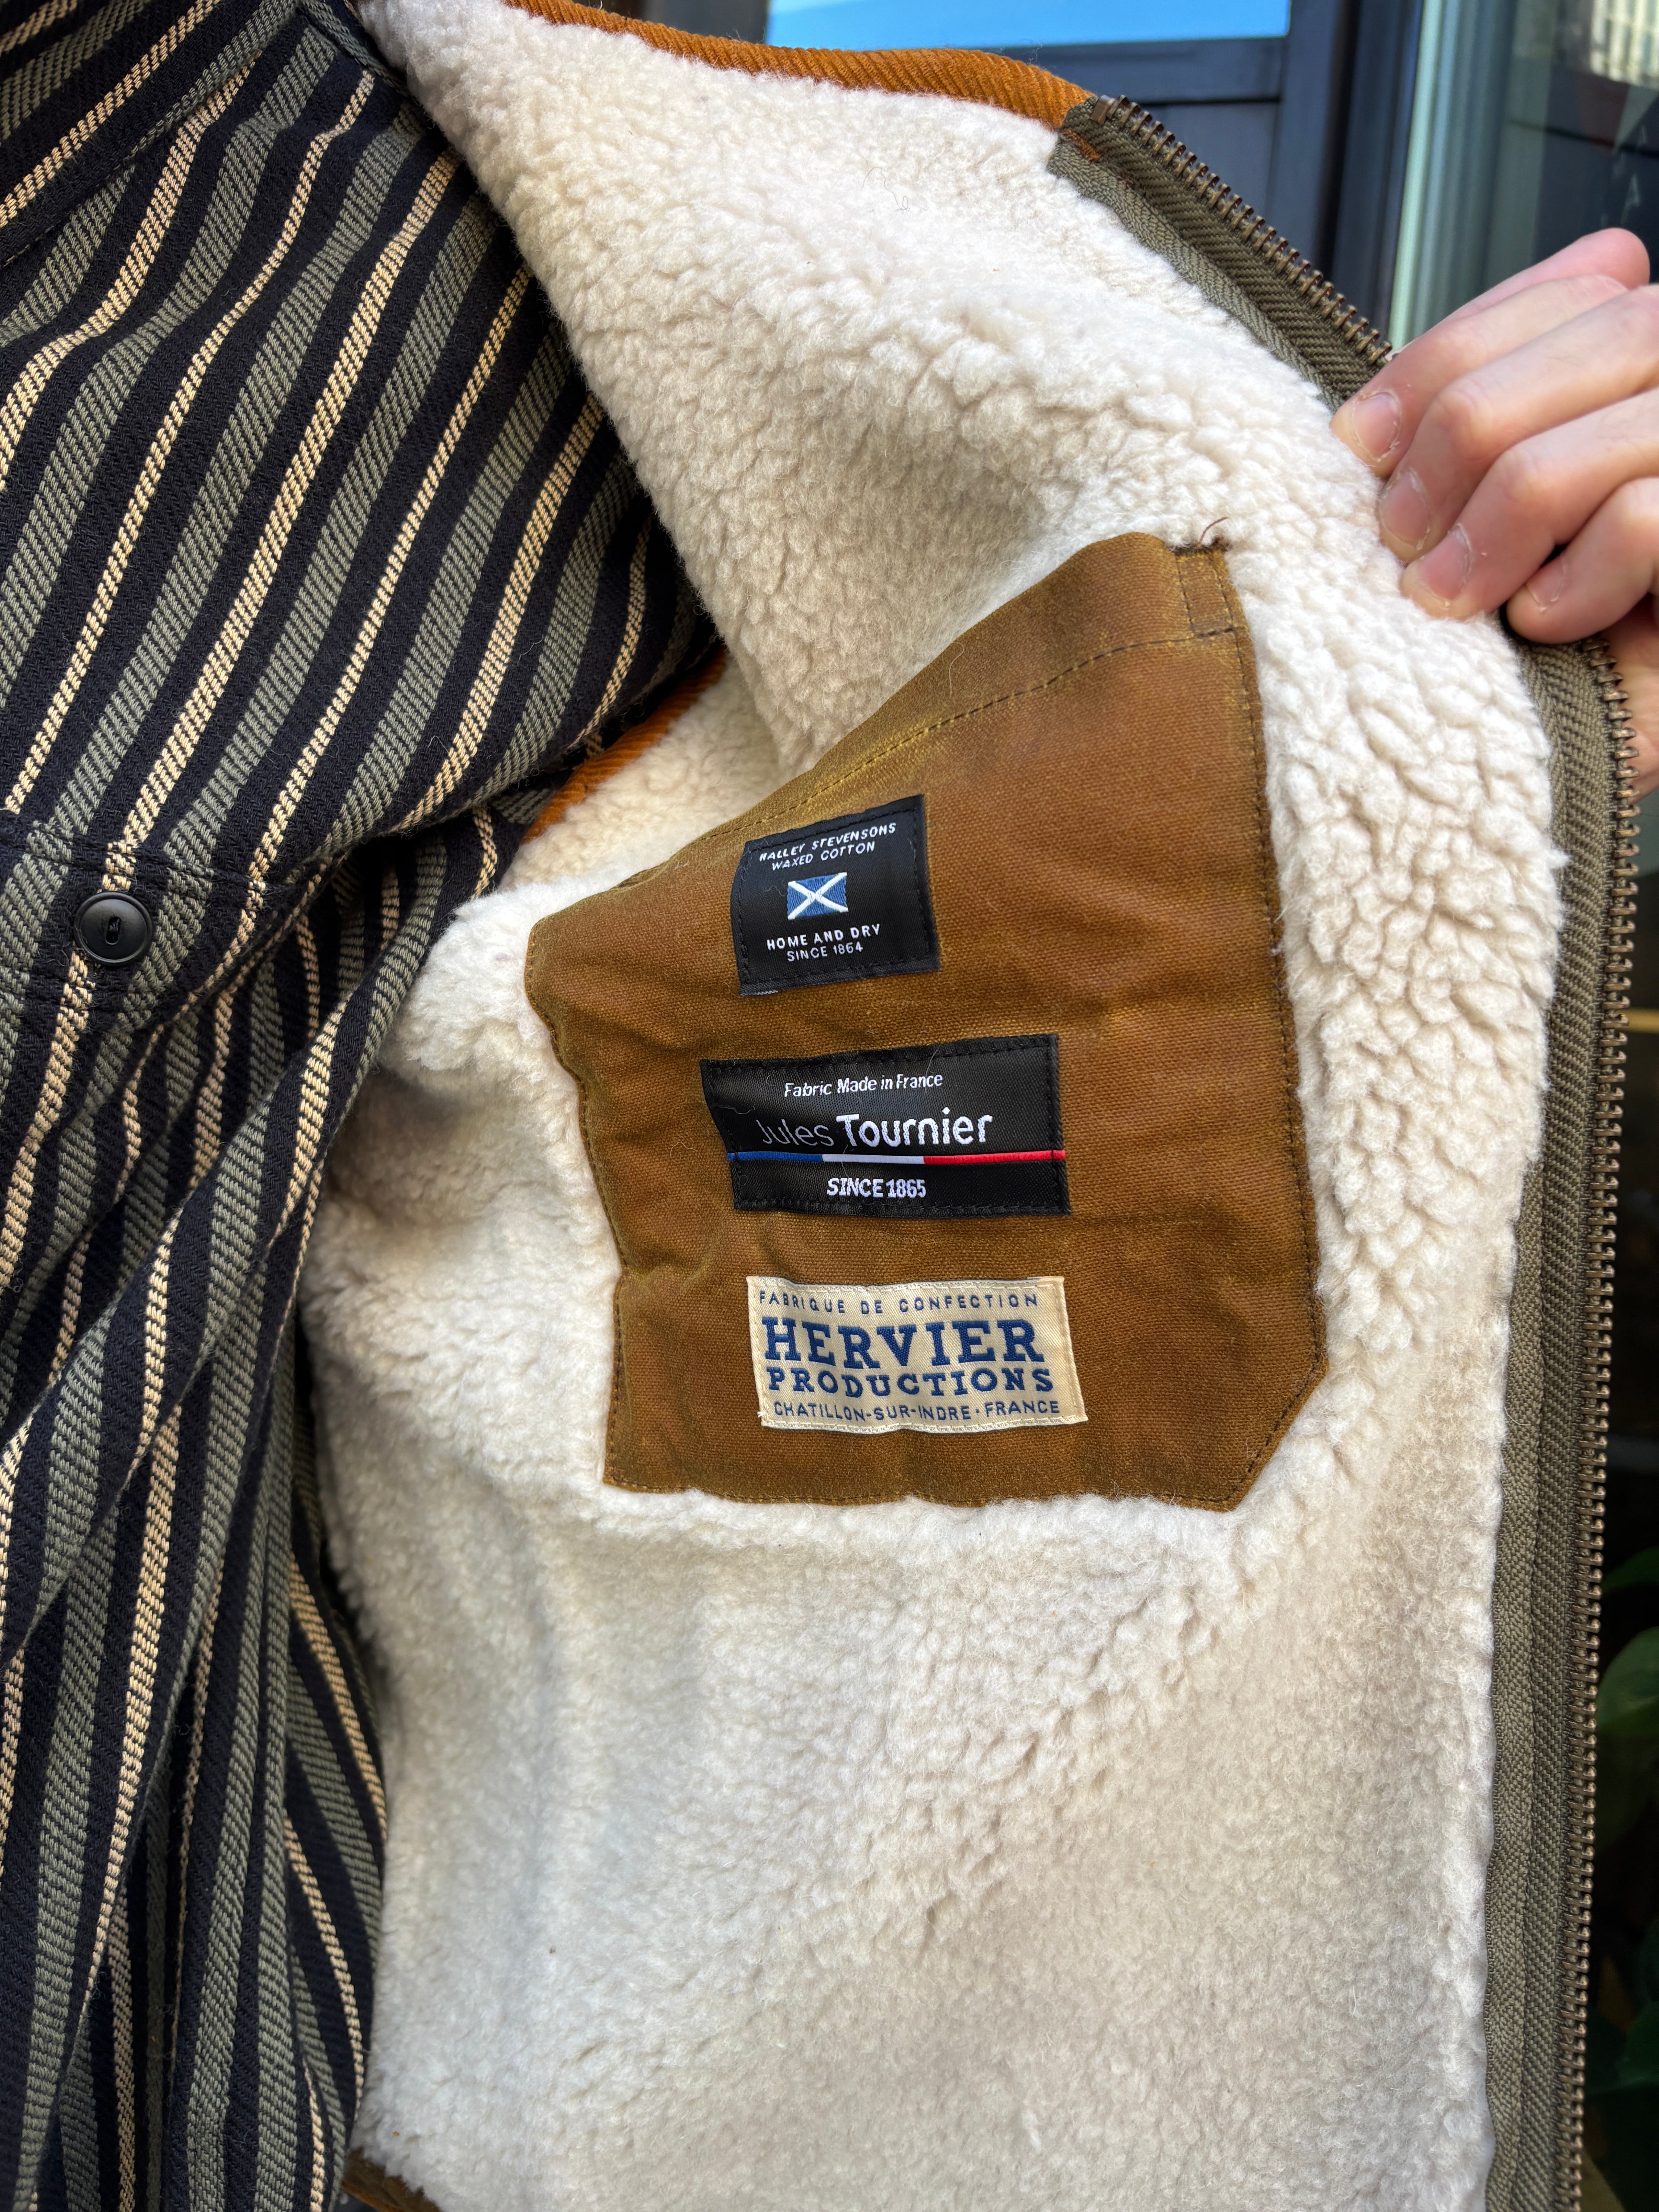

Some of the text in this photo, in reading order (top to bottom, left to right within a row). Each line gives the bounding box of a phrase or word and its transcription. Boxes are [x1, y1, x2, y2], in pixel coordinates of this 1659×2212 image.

[759, 822, 896, 862] HALLEY STEVENSONS
[772, 841, 875, 871] WAXED COTTON
[767, 923, 880, 950] HOME AND DRY
[787, 941, 863, 961] SINCE 1864
[784, 1073, 943, 1097] Fabric Made in France
[756, 1107, 993, 1147] Jules Tournier
[826, 1178, 926, 1198] SINCE 1865
[759, 1290, 1037, 1314] FABRIQUE DE CONFECTION
[762, 1317, 1044, 1369] HERVIER
[766, 1367, 1054, 1398] PRODUCTIONS
